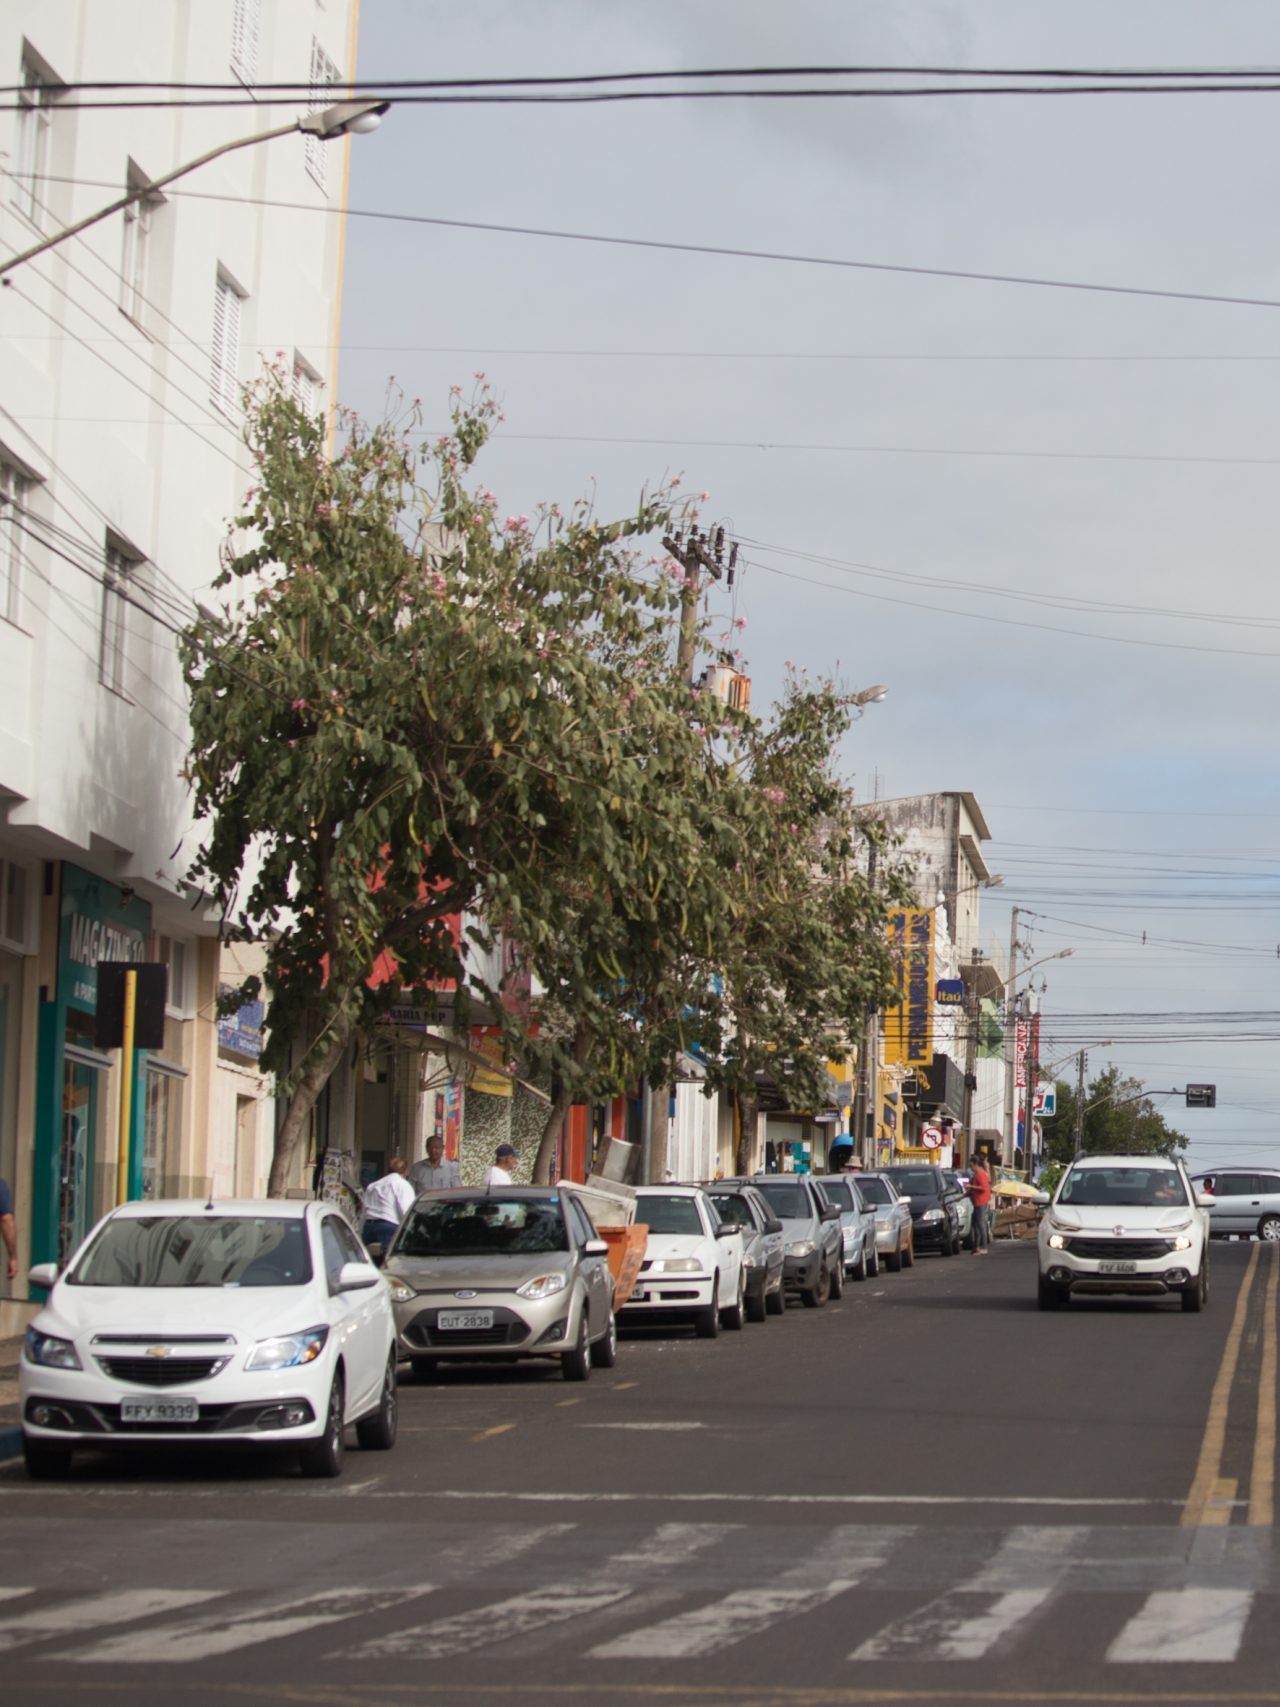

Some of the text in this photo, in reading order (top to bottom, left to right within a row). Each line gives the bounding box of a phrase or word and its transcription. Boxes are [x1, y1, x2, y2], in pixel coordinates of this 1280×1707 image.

[69, 910, 130, 969] MAGAZINE
[908, 913, 930, 1061] PERNAMBUCANAS
[937, 990, 962, 1002] Itaú
